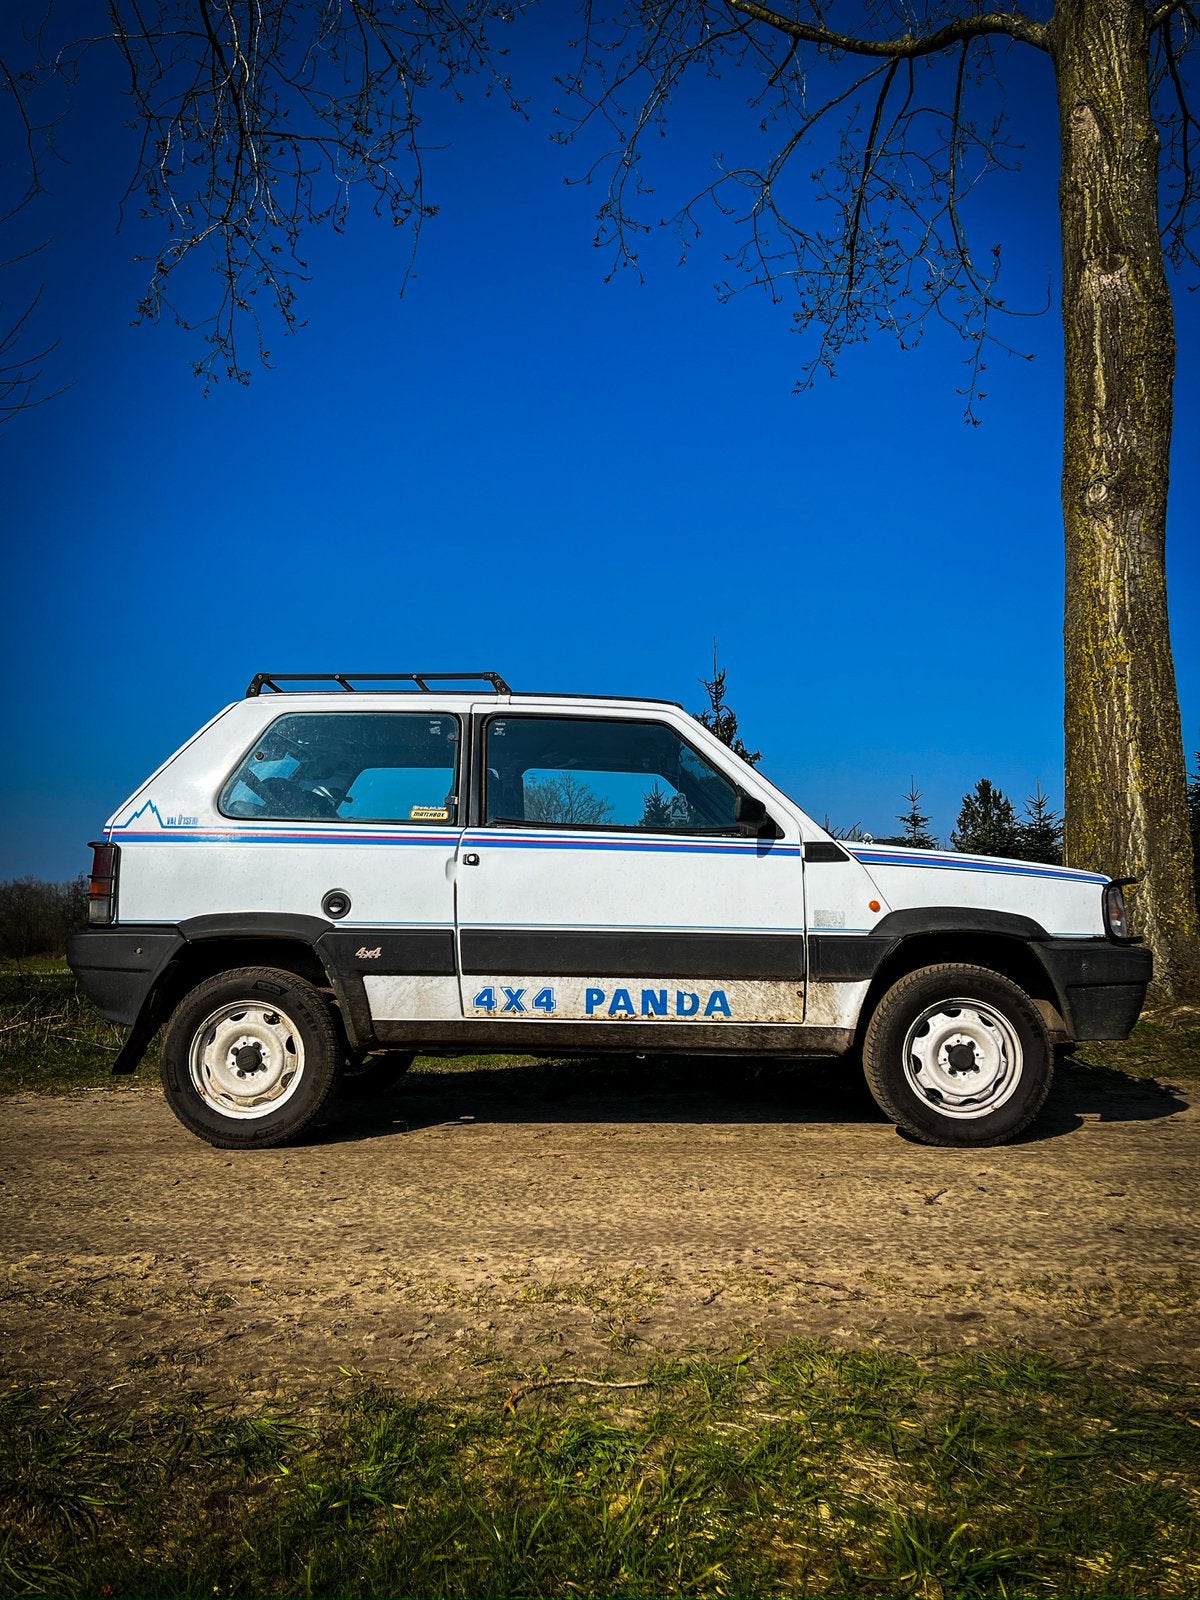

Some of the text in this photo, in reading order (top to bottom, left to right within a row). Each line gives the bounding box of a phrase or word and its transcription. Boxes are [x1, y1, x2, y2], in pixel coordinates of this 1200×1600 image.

[355, 946, 382, 959] 4x4
[473, 986, 732, 1017] 4X4 PANDA
